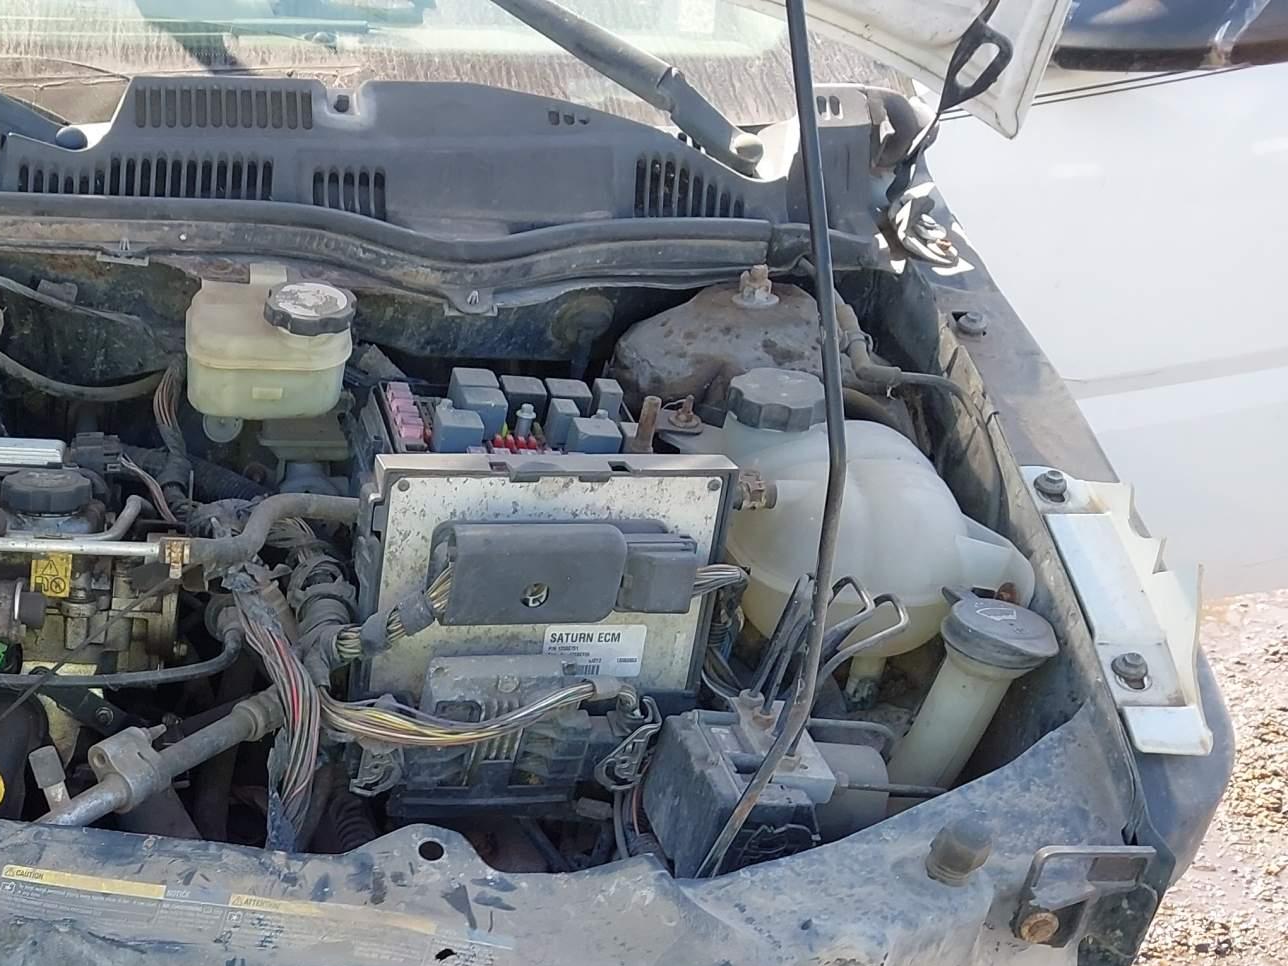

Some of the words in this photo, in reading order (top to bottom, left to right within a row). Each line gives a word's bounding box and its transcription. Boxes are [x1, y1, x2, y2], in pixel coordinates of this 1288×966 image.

[550, 632, 594, 643] SATURN
[597, 632, 621, 643] ECM
[15, 869, 44, 880] CAUTION
